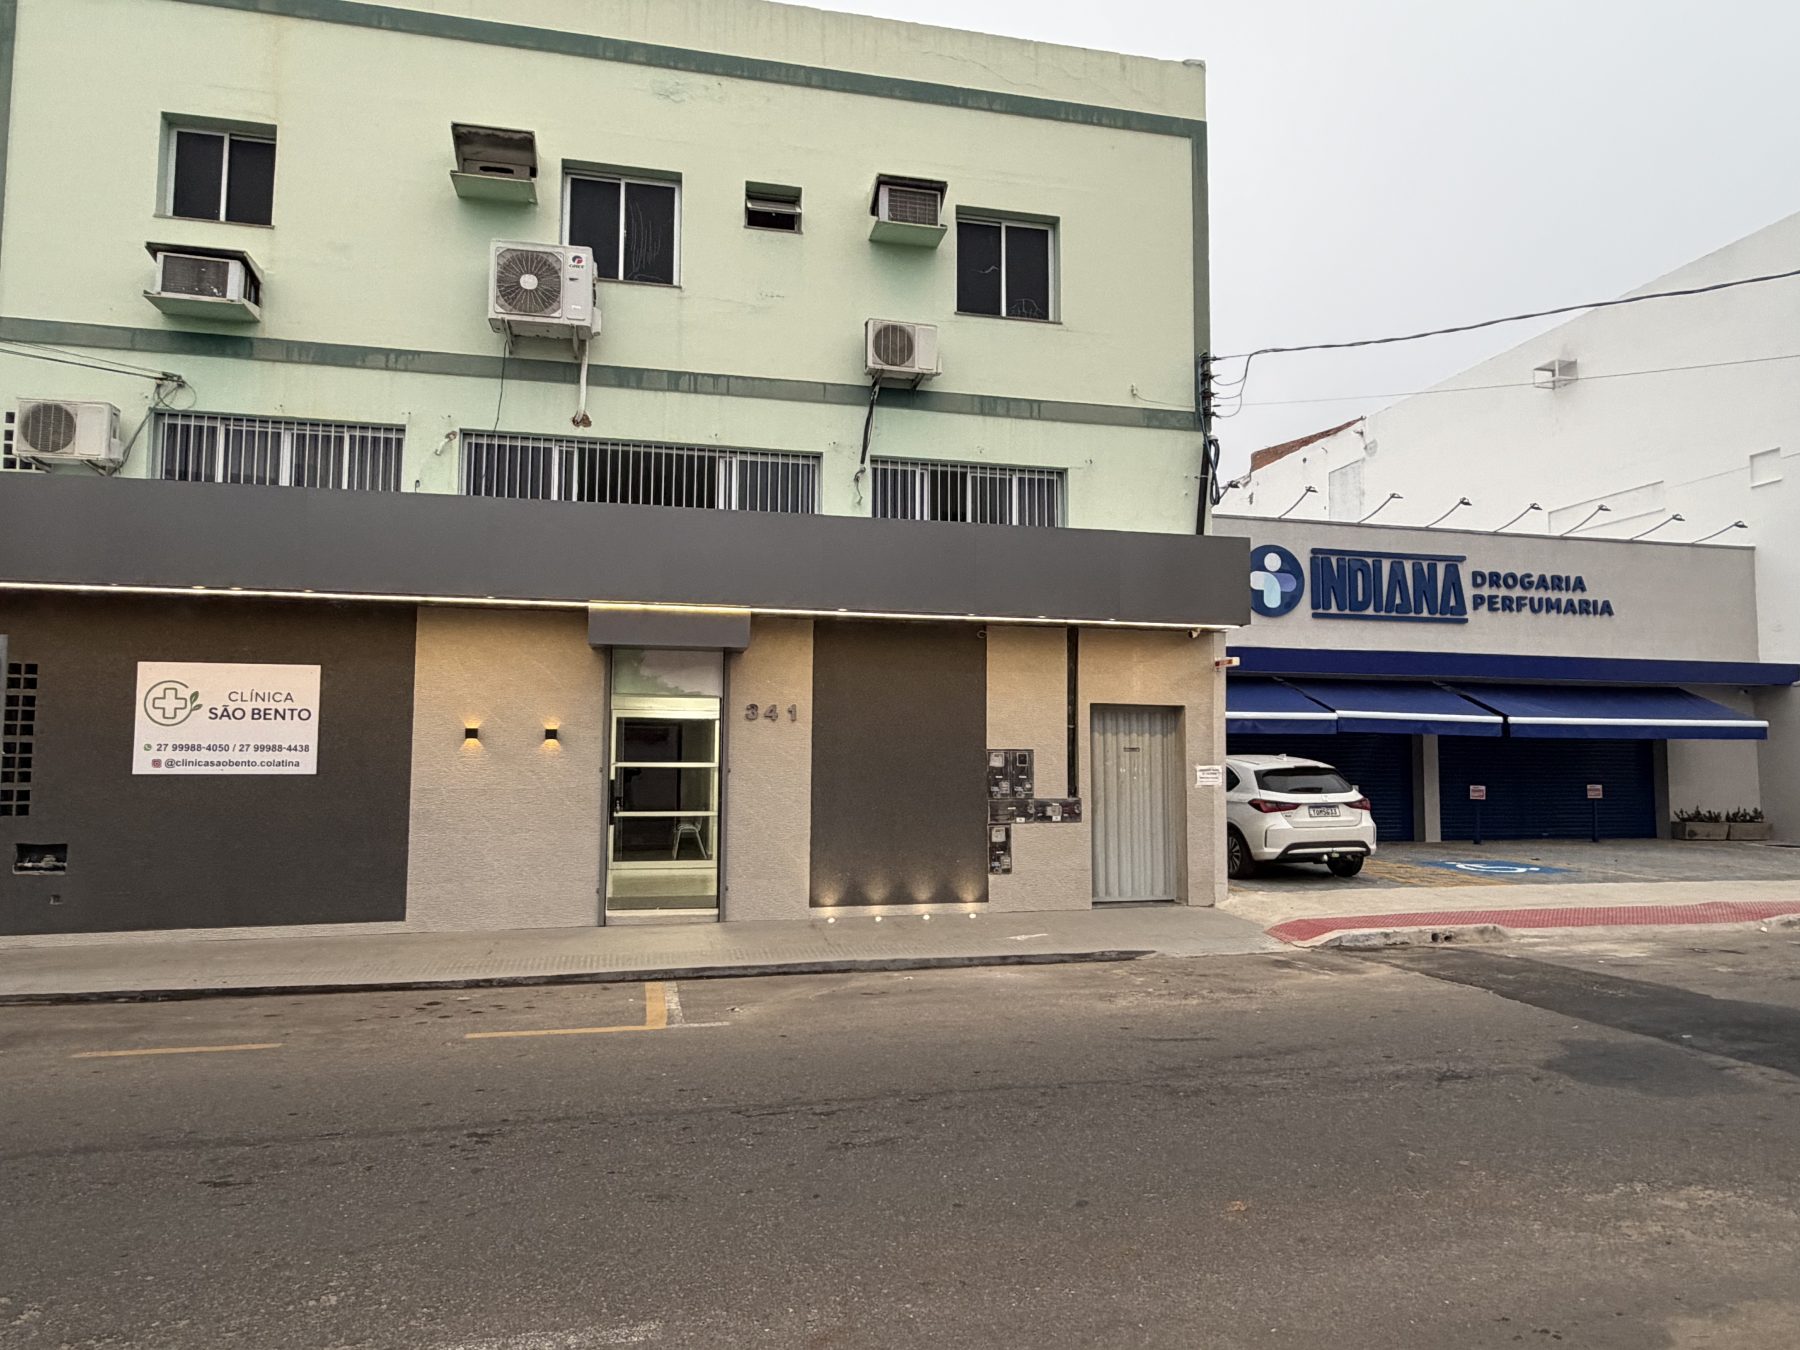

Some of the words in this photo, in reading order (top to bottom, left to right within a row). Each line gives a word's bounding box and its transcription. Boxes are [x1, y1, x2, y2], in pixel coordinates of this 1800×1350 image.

[1310, 555, 1468, 616] INDIANA
[1472, 570, 1587, 593] DROGARIA
[1472, 594, 1614, 617] PERFUMARIA
[228, 689, 295, 703] CLÍNICA
[208, 705, 246, 721] SÃO
[251, 708, 312, 721] BENTO
[745, 703, 797, 723] 341
[156, 743, 169, 752] 27
[171, 743, 230, 752] 99988-4050
[239, 744, 250, 752] 27
[253, 744, 310, 753] 99988-4438
[164, 758, 300, 768] @clinicasaobento.colatina
